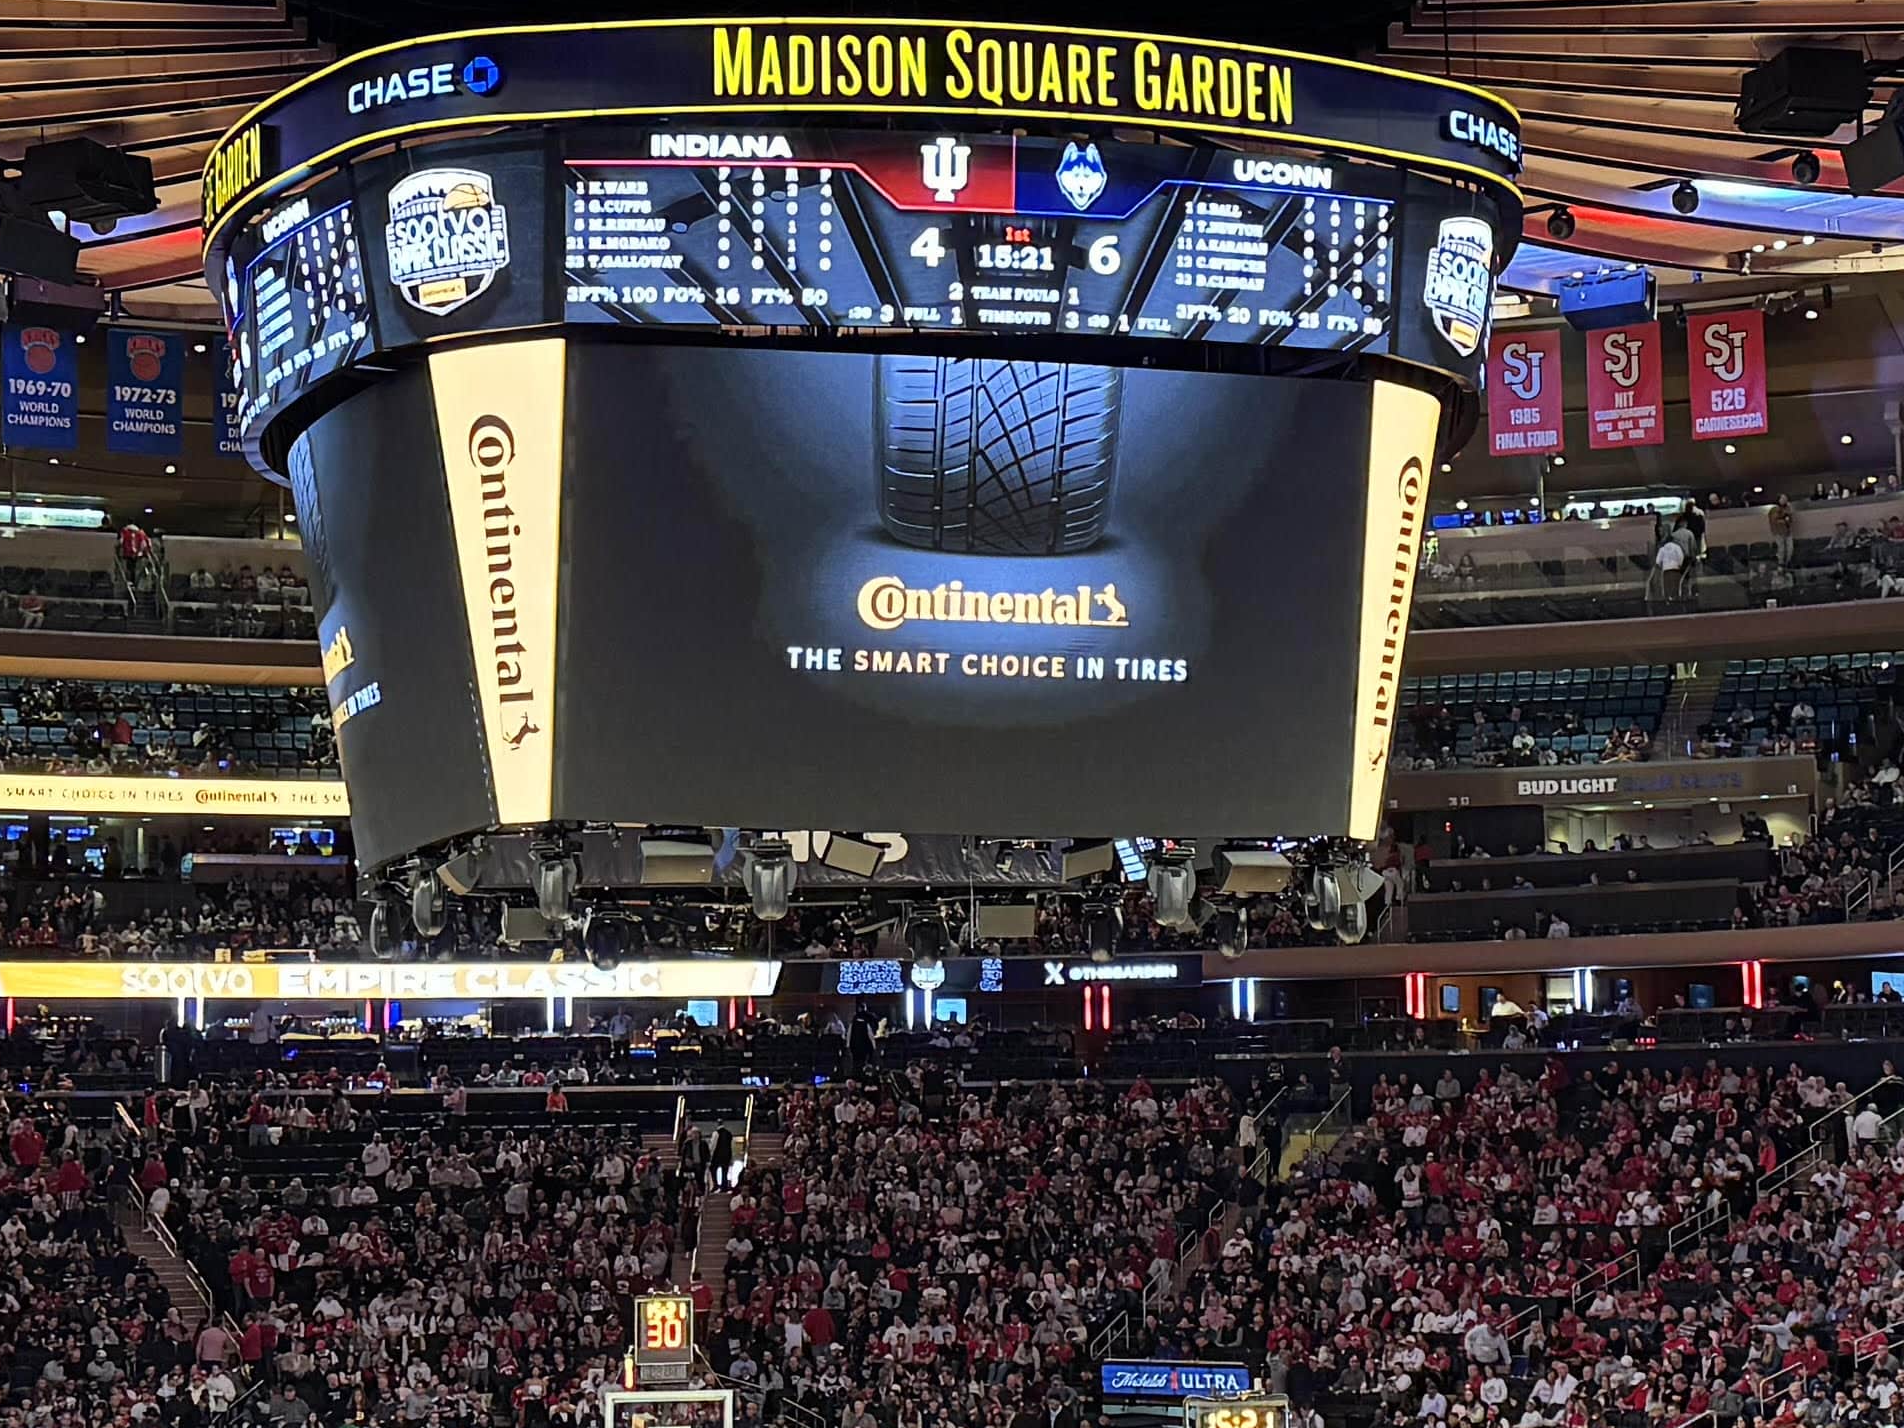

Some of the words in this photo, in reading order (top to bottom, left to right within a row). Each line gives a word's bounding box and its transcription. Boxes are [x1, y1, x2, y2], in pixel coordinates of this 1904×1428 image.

[713, 25, 928, 99] MADISON
[944, 29, 1118, 108] SQUARE
[1133, 43, 1294, 125] GARDEN
[348, 63, 455, 114] CHASE
[650, 134, 794, 159] INDIANA
[1448, 109, 1517, 159] CHASE
[214, 123, 262, 214] GARDEN
[1233, 158, 1332, 190] UCONN
[1005, 225, 1032, 243] 1st
[910, 227, 945, 268] 4
[977, 244, 1055, 271] 15:21
[1088, 235, 1122, 275] 6
[622, 286, 658, 304] 100
[715, 287, 741, 305] 16
[948, 282, 964, 302] 2
[970, 285, 1012, 302] TEAM
[1227, 307, 1251, 325] 20
[19, 400, 59, 415] WORLD
[1711, 387, 1746, 412] 526
[7, 413, 72, 429] CHAMPIONS
[125, 407, 164, 421] WORLD
[112, 420, 176, 435] CHAMPIONS
[1495, 431, 1527, 450] FINAL
[1529, 429, 1558, 447] FOUR
[468, 414, 534, 704] Continental
[857, 575, 1091, 630] Continental
[787, 646, 842, 670] THE
[854, 649, 950, 675] SMART
[961, 654, 1065, 678] CHOICE
[1076, 656, 1104, 680] IN
[1116, 658, 1188, 682] TIRES
[1517, 779, 1559, 796] BUD
[1560, 777, 1617, 795] LIGHT
[278, 969, 457, 996] EMPIRE
[465, 964, 662, 995] CLASSIC
[647, 1319, 682, 1348] 30
[1181, 1373, 1240, 1390] ULTRA
